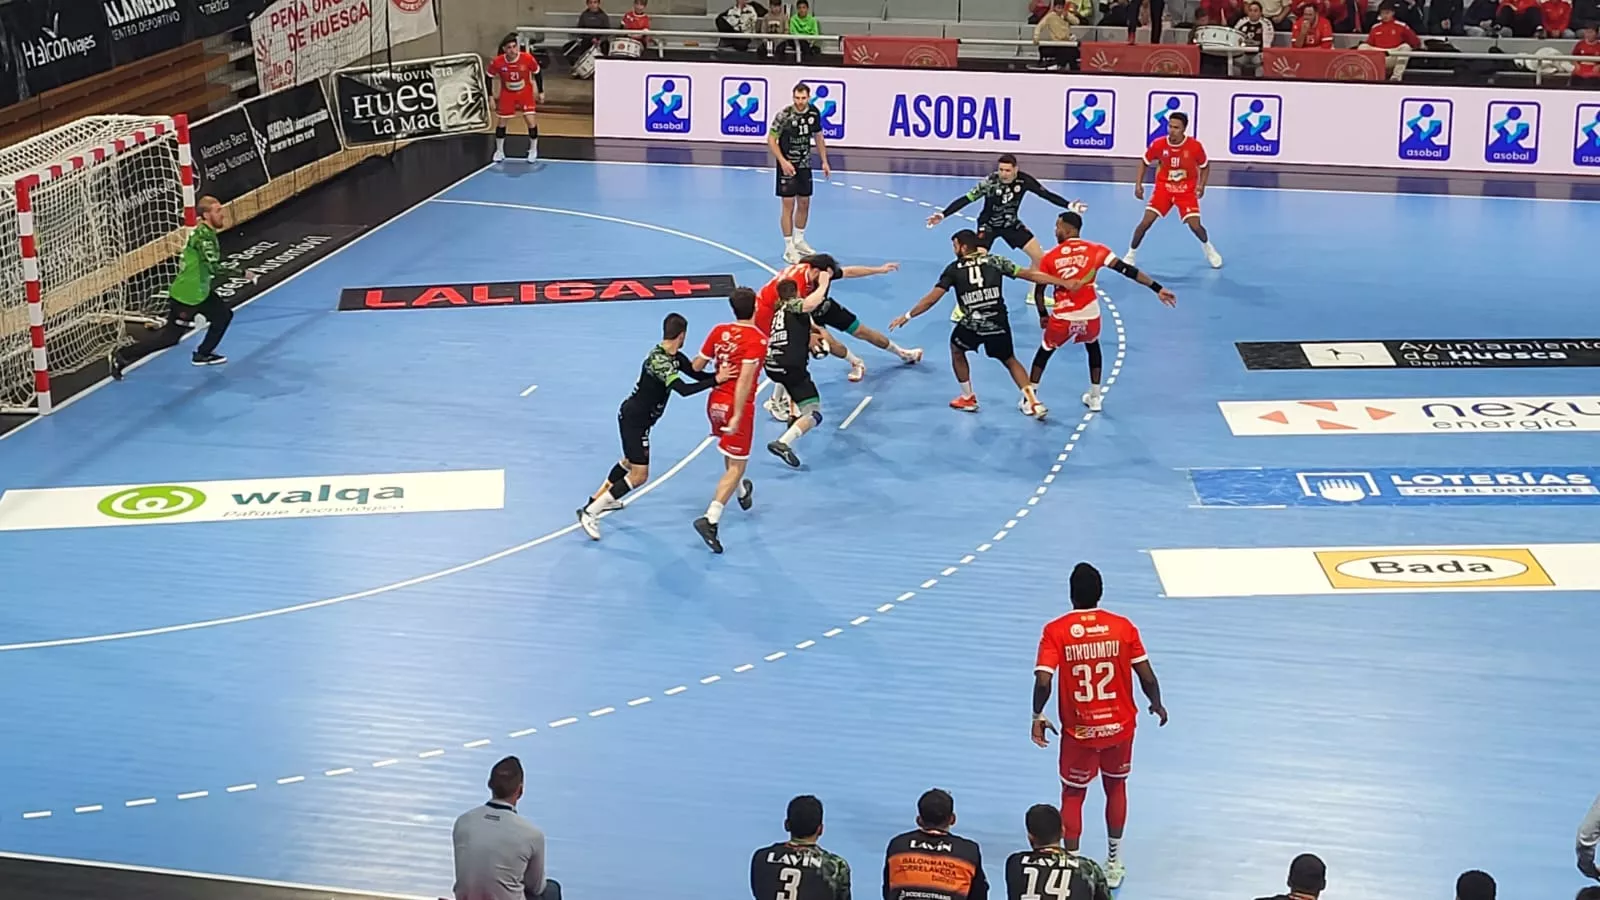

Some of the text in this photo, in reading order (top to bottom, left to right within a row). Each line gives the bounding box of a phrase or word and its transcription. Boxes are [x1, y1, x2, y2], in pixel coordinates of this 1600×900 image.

[138, 11, 180, 32] DEPORTIVO
[288, 2, 371, 52] DE HUESCA
[889, 93, 1020, 140] ASOBAL
[652, 121, 684, 130] asobal
[728, 124, 760, 133] asobal
[822, 127, 837, 137] bal
[1072, 135, 1106, 146] asobal
[1238, 141, 1272, 152] asobal
[1405, 147, 1442, 158] asobal
[1493, 150, 1530, 161] asobal
[968, 266, 984, 288] 4
[1403, 351, 1568, 361] de Huesca
[1433, 416, 1577, 430] energía
[1391, 471, 1592, 485] LOTERÍAS
[231, 483, 405, 506] walqa
[1369, 560, 1495, 575] Bada
[1072, 662, 1117, 702] 32
[776, 867, 801, 900] 3
[1021, 867, 1072, 900] 14
